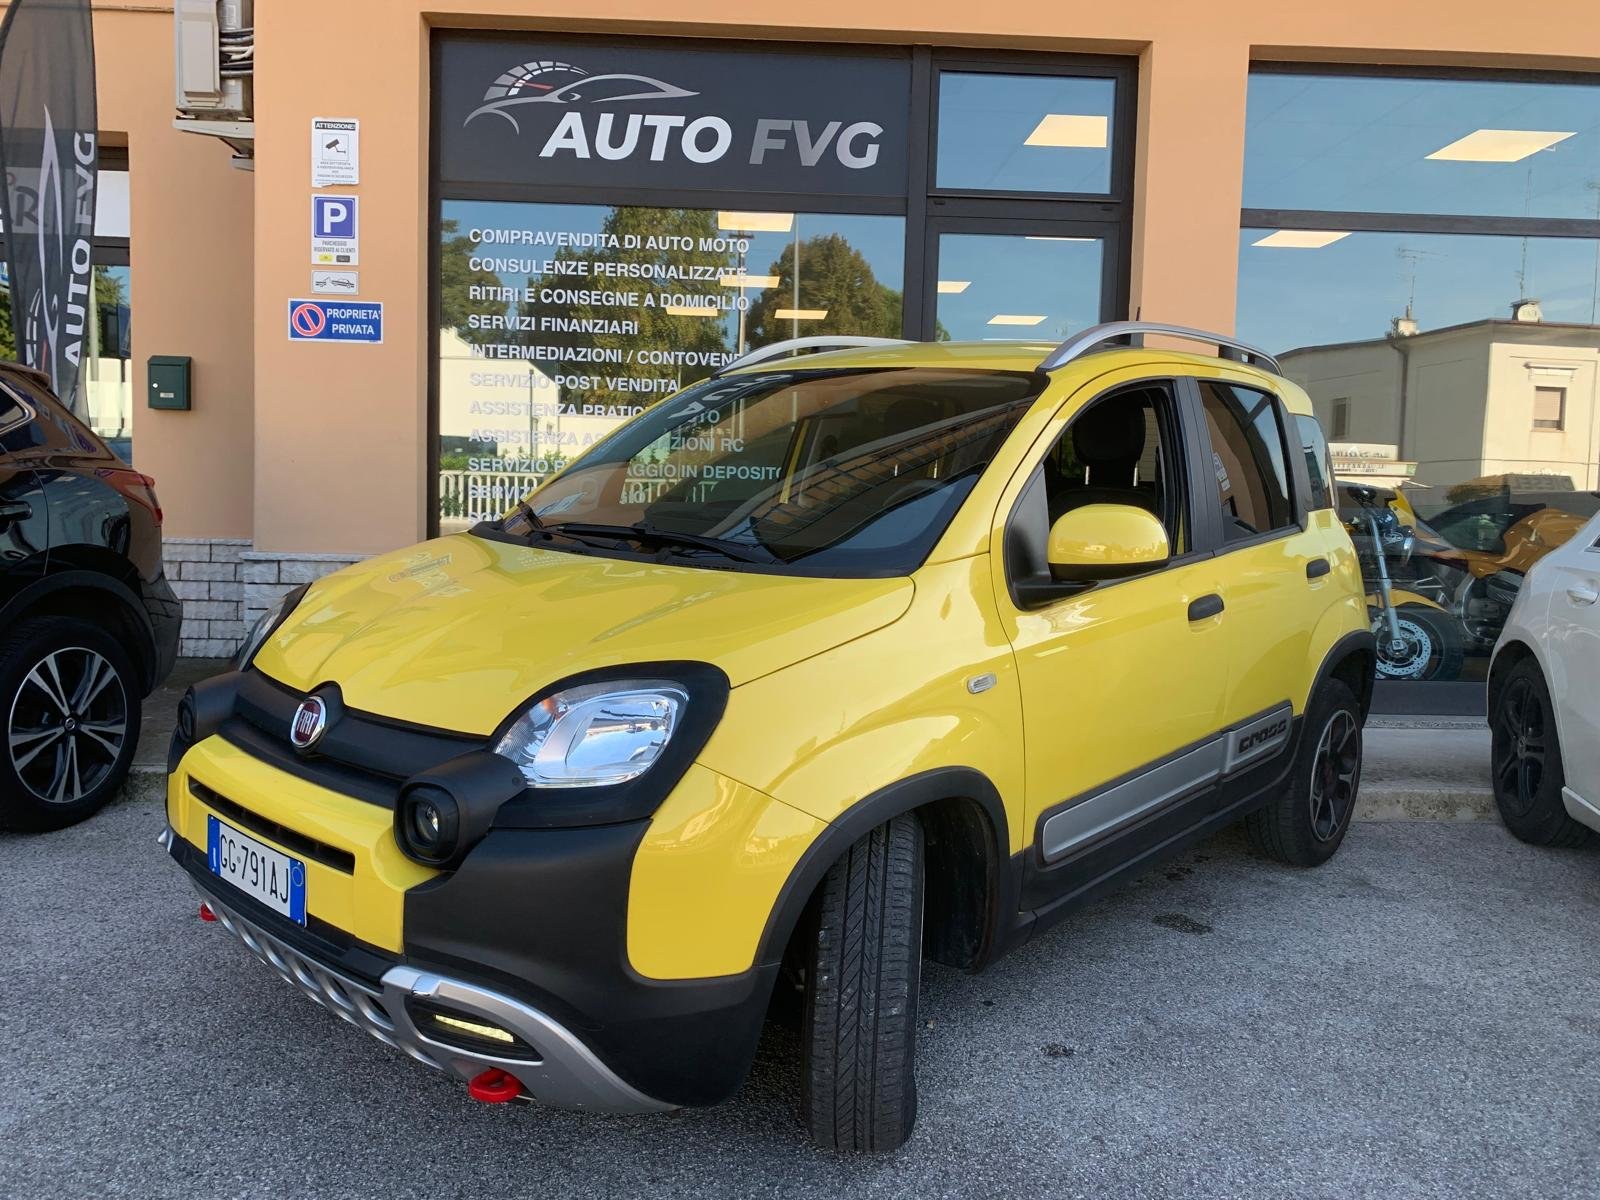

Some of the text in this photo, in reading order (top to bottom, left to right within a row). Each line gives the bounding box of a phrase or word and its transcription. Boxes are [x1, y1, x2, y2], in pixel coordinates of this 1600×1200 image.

[538, 111, 884, 169] AUTO FVG
[64, 131, 95, 368] AUTO FVG
[469, 228, 750, 253] COMPRAVENDITA DI AUTO MOTO
[469, 257, 747, 280] CONSULENZE PERSONALIZZATE
[469, 286, 750, 311] RITIRI E CONSEGNE A DOMICILIO
[332, 323, 375, 335] PRIVATA
[468, 315, 639, 335] SERVIZI FINANZIARI
[471, 343, 622, 363] INTERMEDIAZIONI
[470, 372, 680, 393] SERVIZIO POST VENDITA
[470, 400, 577, 417] ASSISTENZA
[468, 429, 578, 446] ASSISTENZA
[721, 437, 744, 452] RC
[468, 457, 549, 473] SERVIZIO
[682, 465, 698, 478] IN
[468, 485, 538, 499] SERVIZ
[297, 709, 319, 736] FIAT
